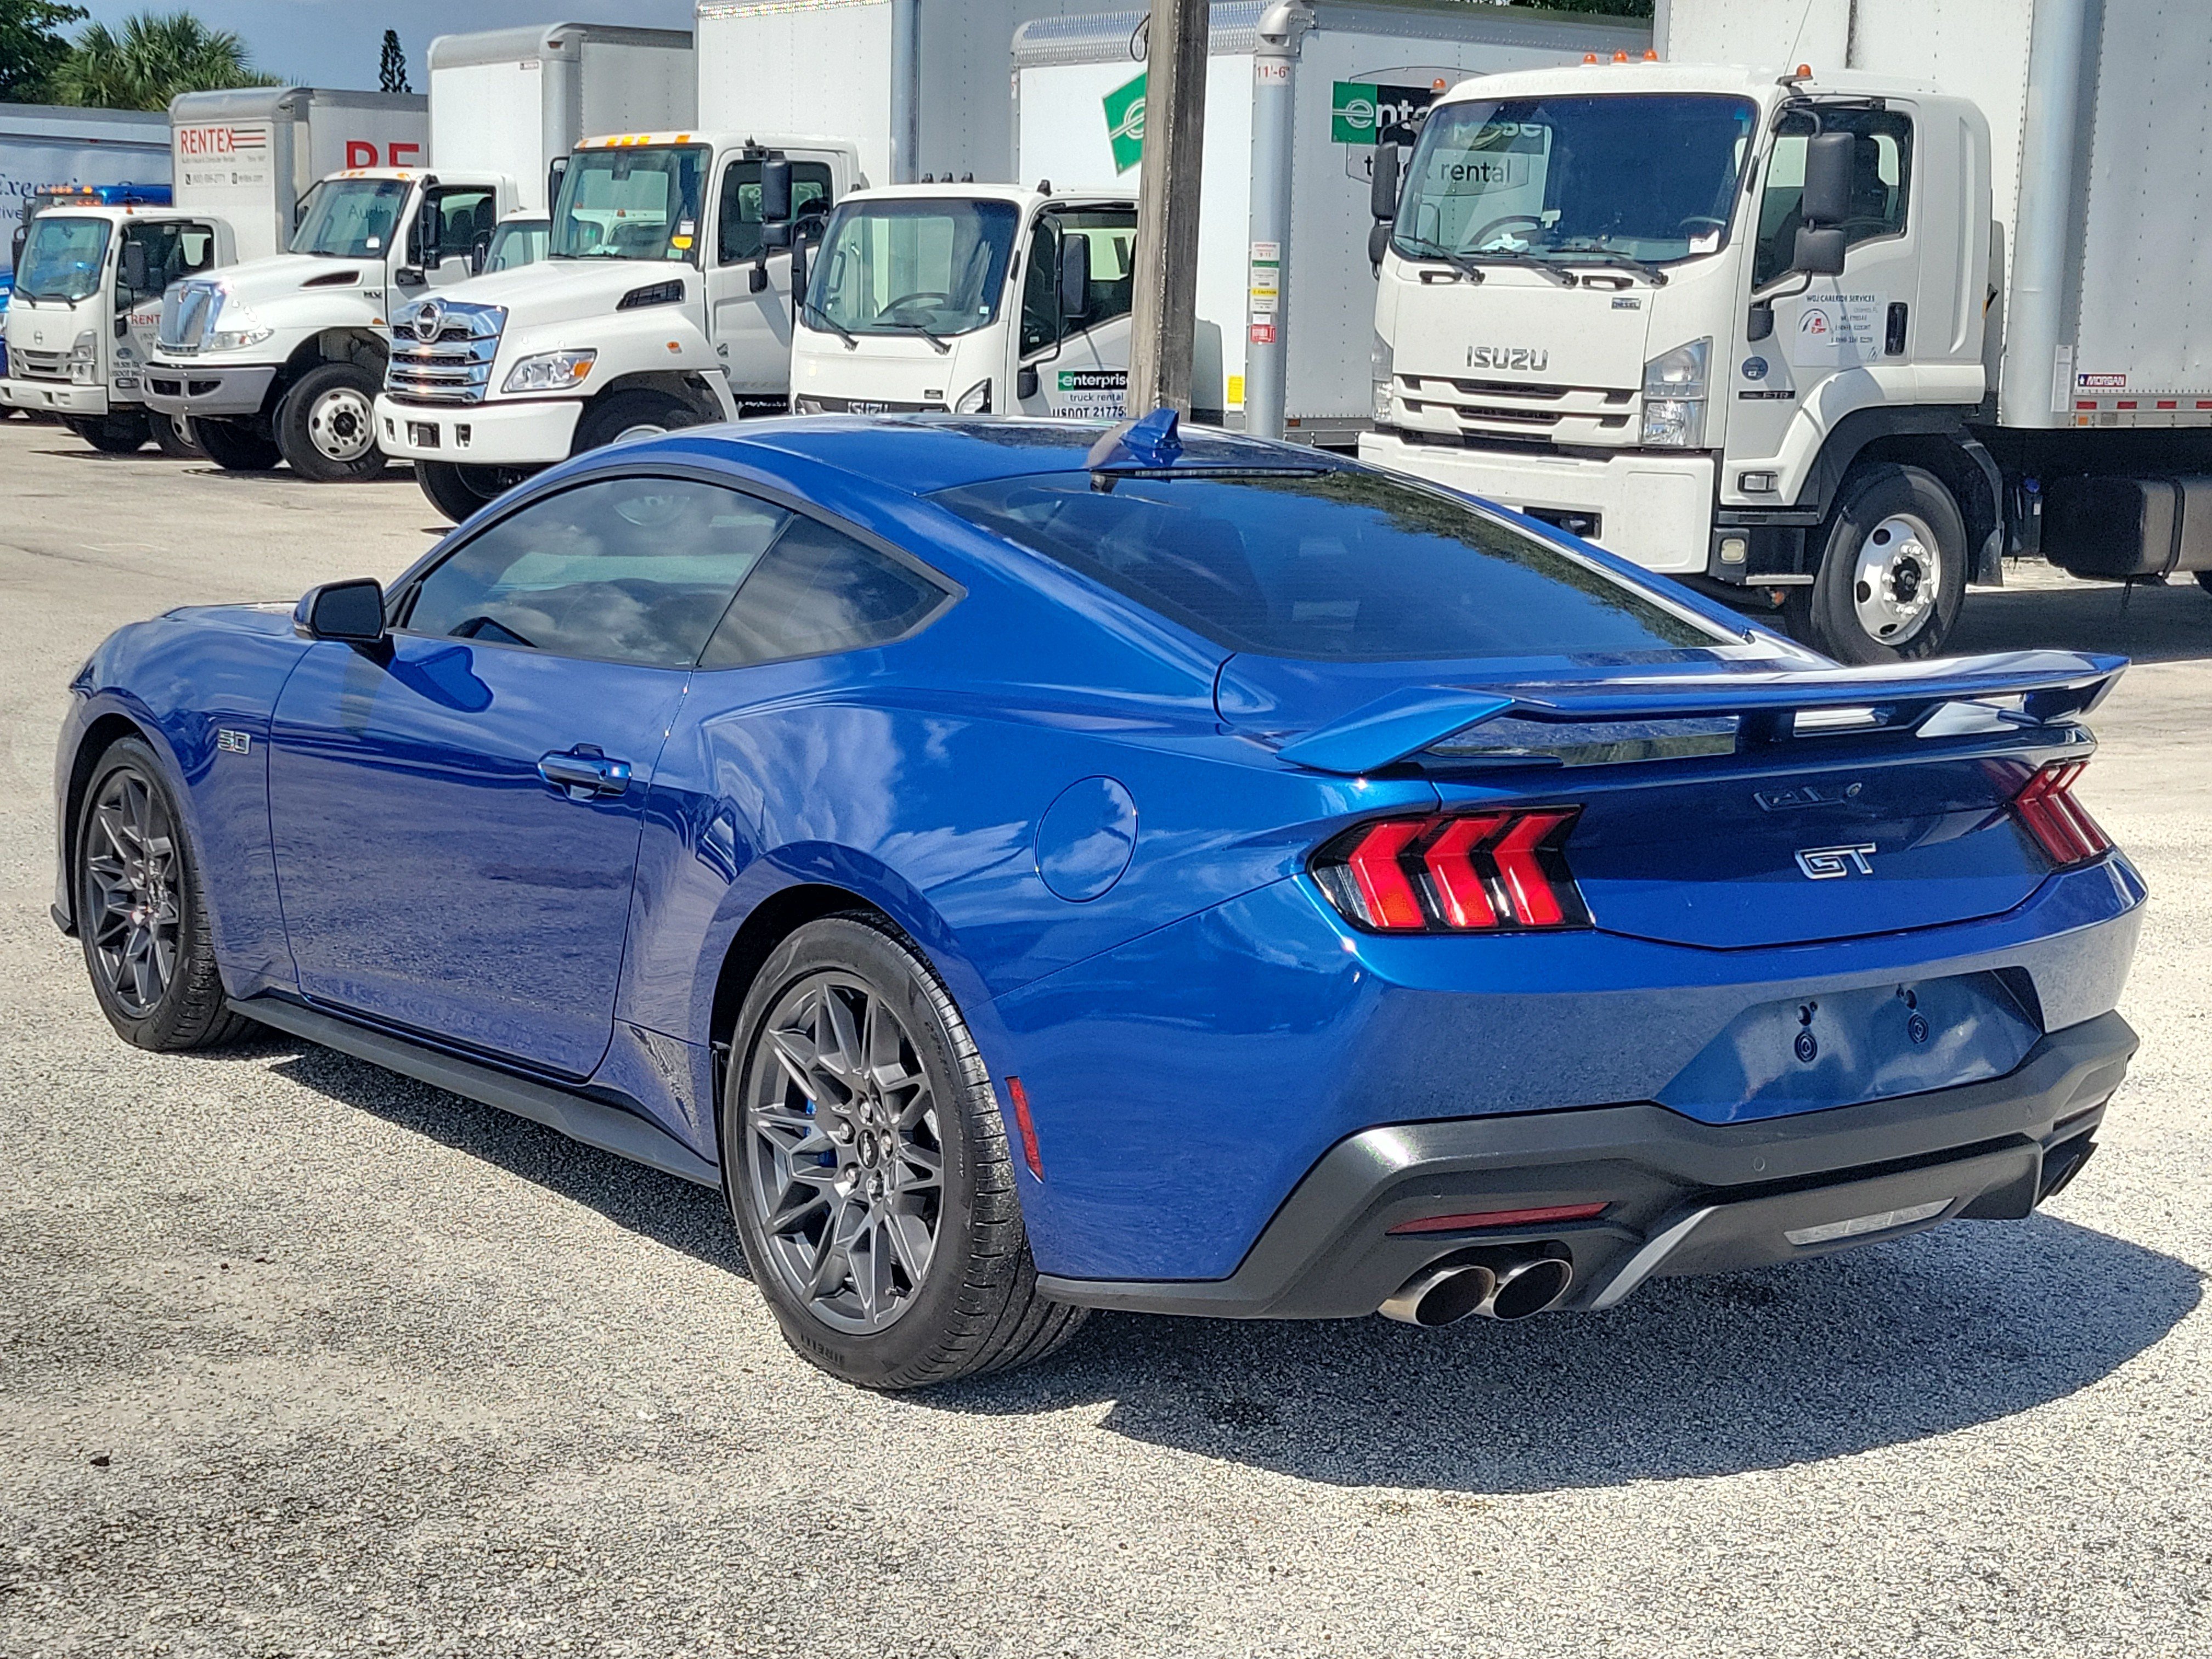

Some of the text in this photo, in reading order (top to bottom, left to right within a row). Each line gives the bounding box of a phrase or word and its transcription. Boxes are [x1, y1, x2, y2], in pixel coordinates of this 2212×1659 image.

[180, 127, 236, 154] RENTEX
[1441, 159, 1511, 183] rental
[1466, 346, 1548, 371] ISUZU
[2086, 376, 2125, 386] MORGAN
[1070, 392, 1124, 402] truck rental
[1795, 842, 1876, 879] GT
